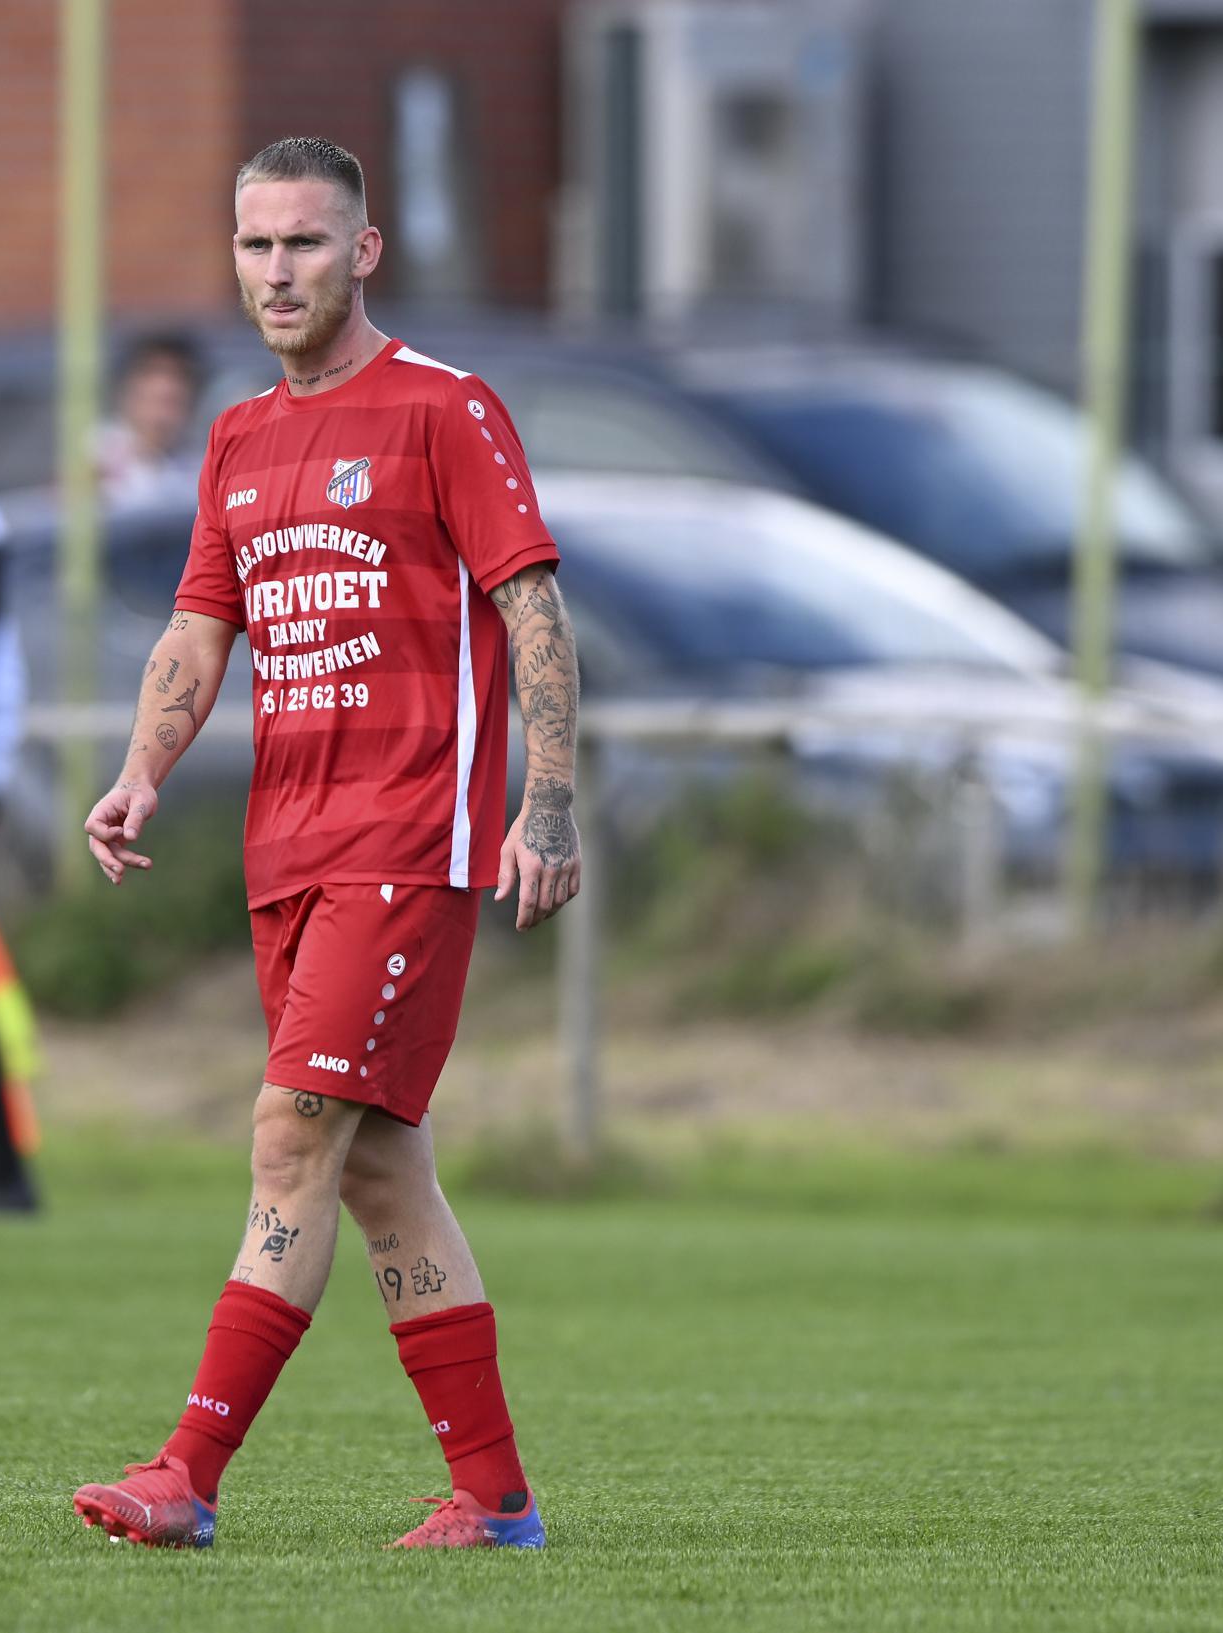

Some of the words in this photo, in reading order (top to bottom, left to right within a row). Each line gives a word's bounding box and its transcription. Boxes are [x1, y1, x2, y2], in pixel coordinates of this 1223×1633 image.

[324, 359, 353, 379] chance
[226, 488, 257, 511] JAKO
[268, 618, 326, 648] DANNY
[340, 682, 369, 708] 39
[308, 1052, 350, 1073] JAKO
